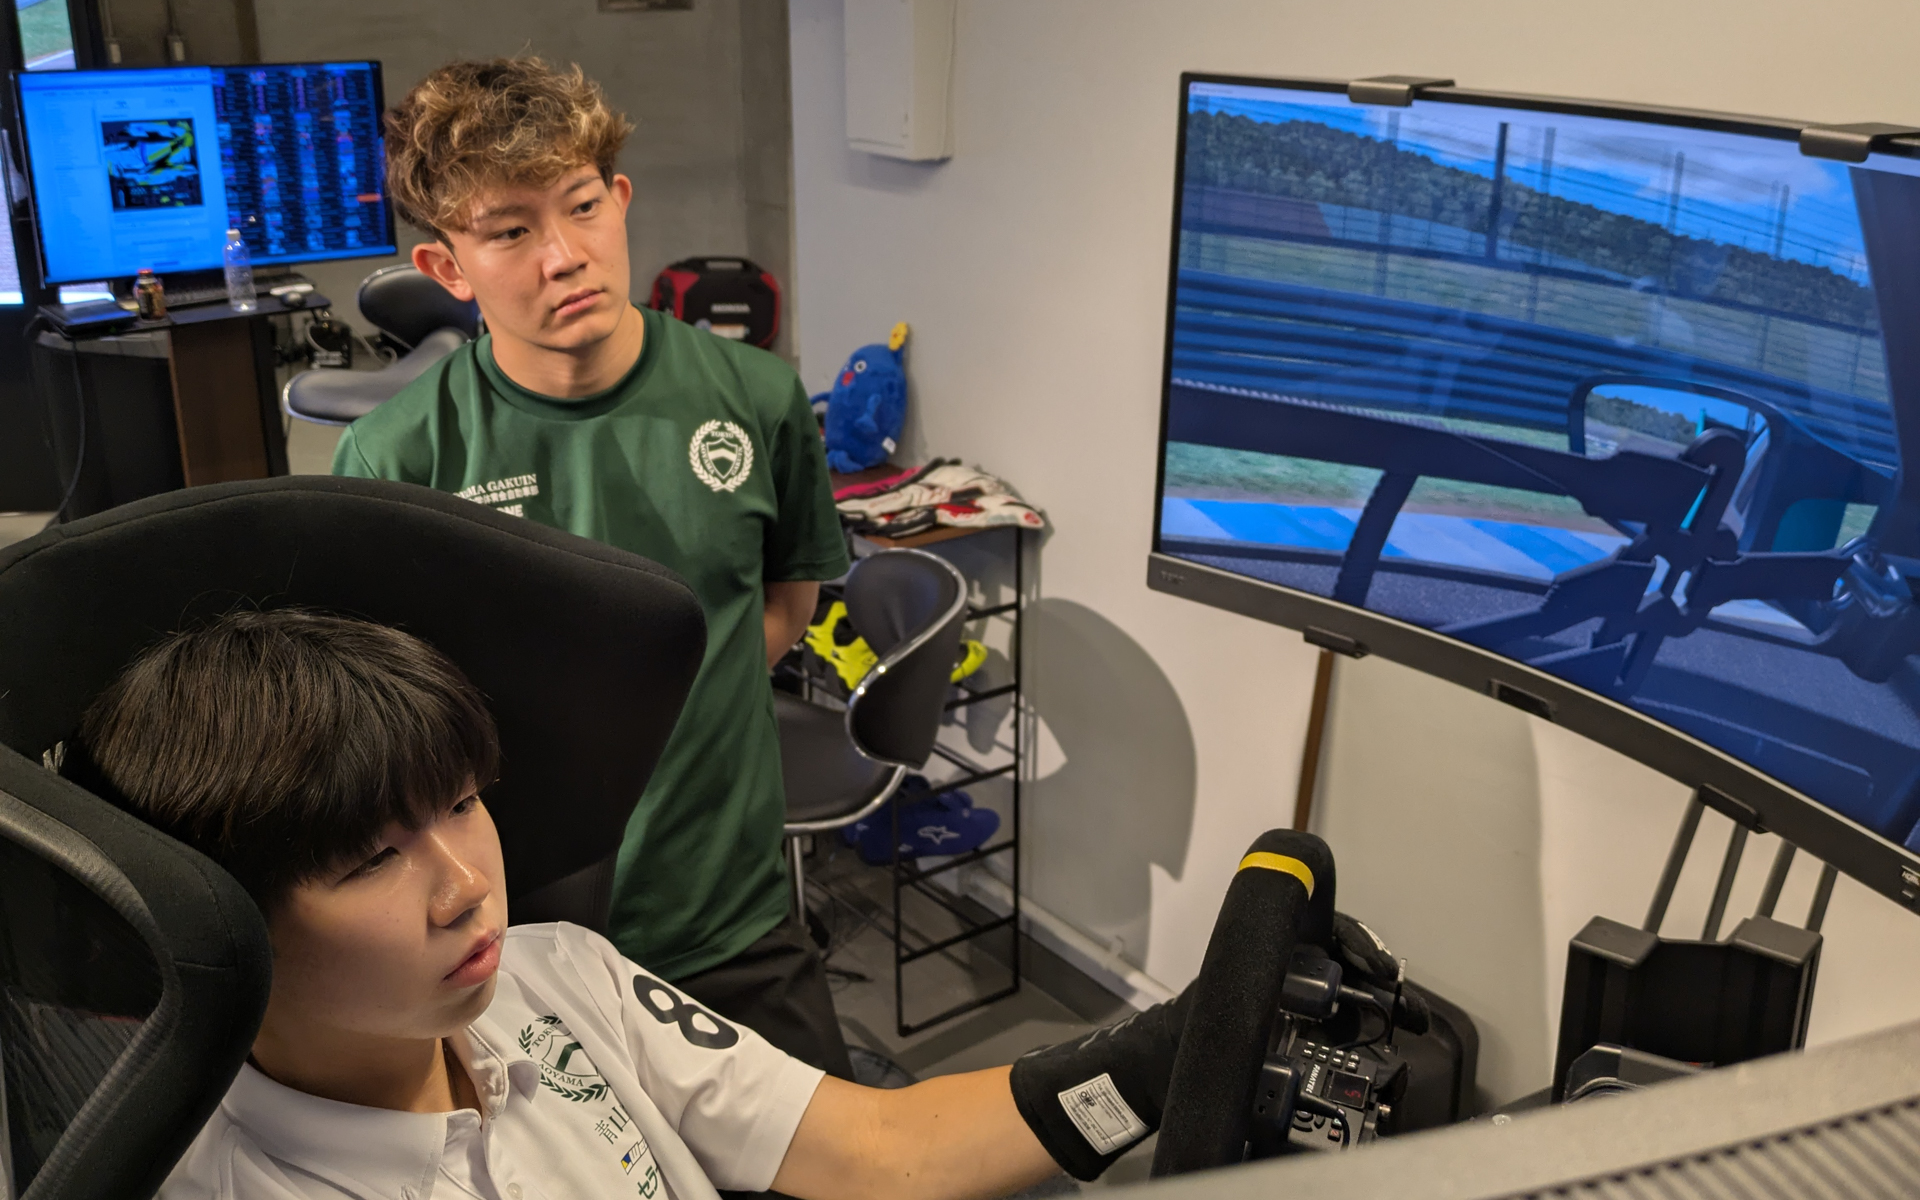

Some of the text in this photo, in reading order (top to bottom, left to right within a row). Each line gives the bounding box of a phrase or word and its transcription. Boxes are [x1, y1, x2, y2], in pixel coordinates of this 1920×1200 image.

[486, 473, 537, 492] GAKUIN
[633, 974, 740, 1050] 8
[539, 1063, 584, 1087] AOYAMA
[1305, 1063, 1321, 1094] FANATEC
